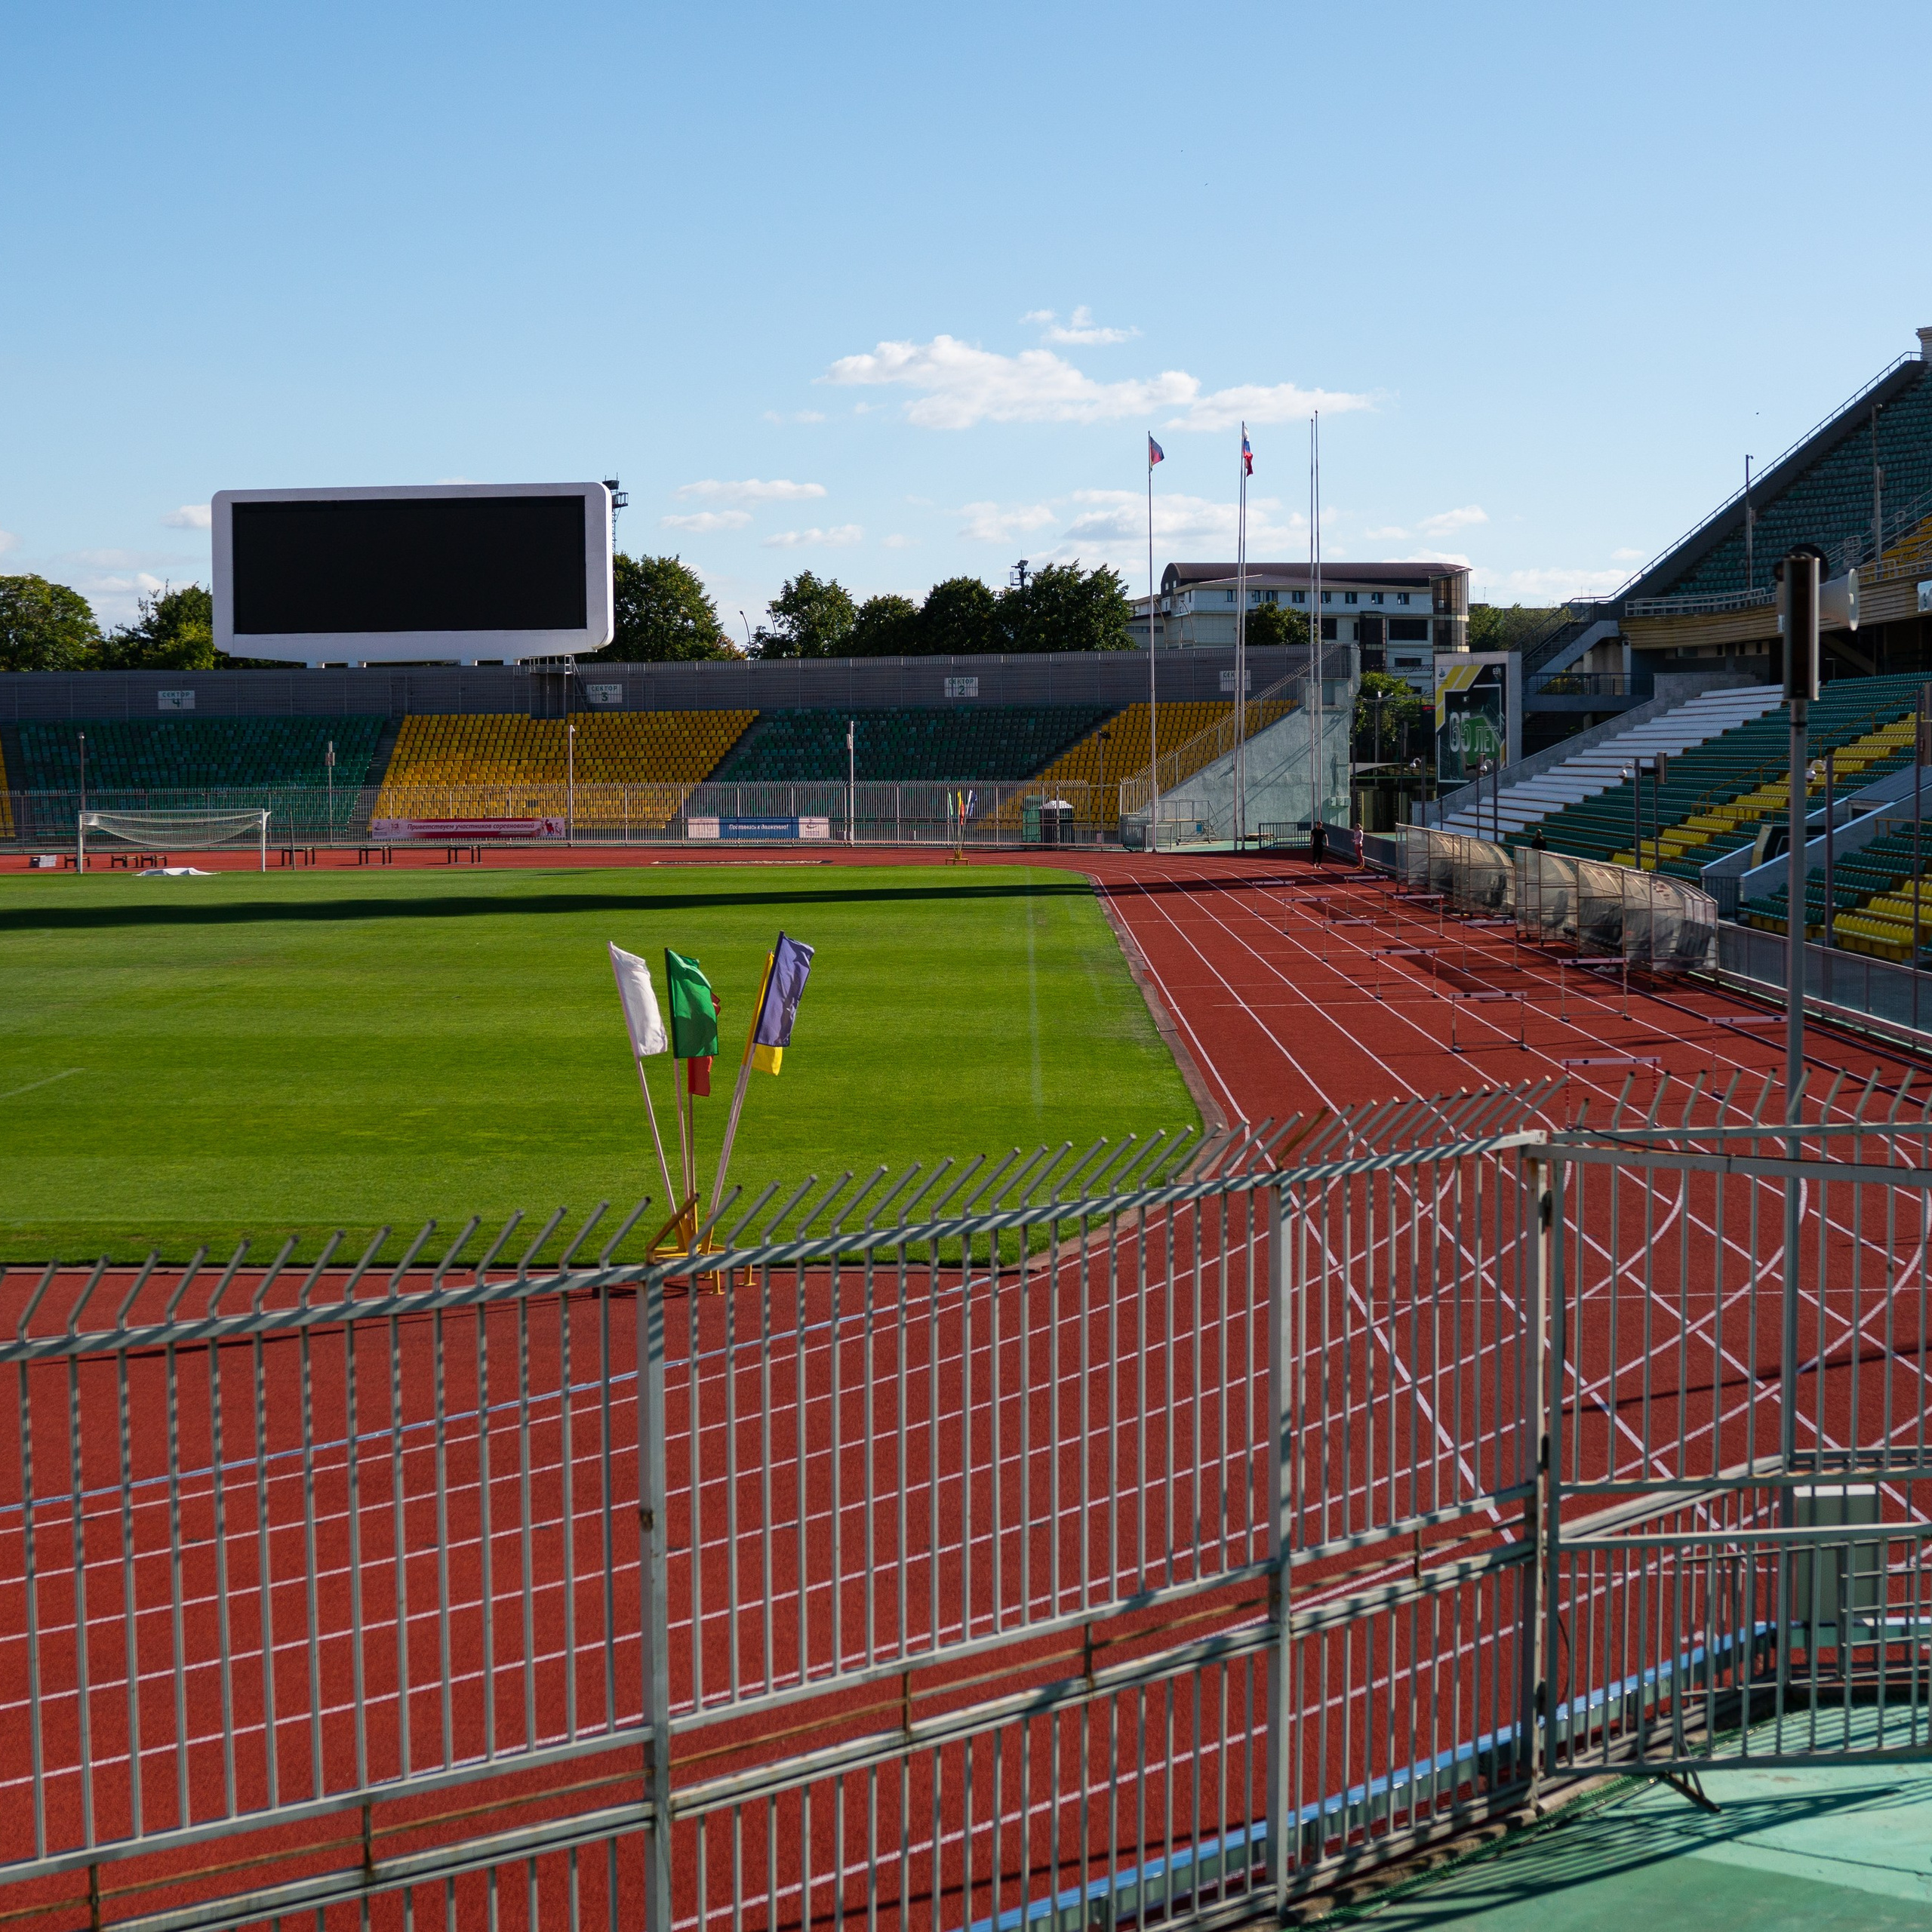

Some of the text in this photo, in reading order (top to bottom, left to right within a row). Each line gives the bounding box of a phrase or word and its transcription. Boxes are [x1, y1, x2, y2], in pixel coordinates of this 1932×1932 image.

[958, 685, 965, 695] 2
[172, 698, 180, 708] 4
[1449, 712, 1499, 752] 65 ЛЕТ
[493, 822, 535, 830] соревнований
